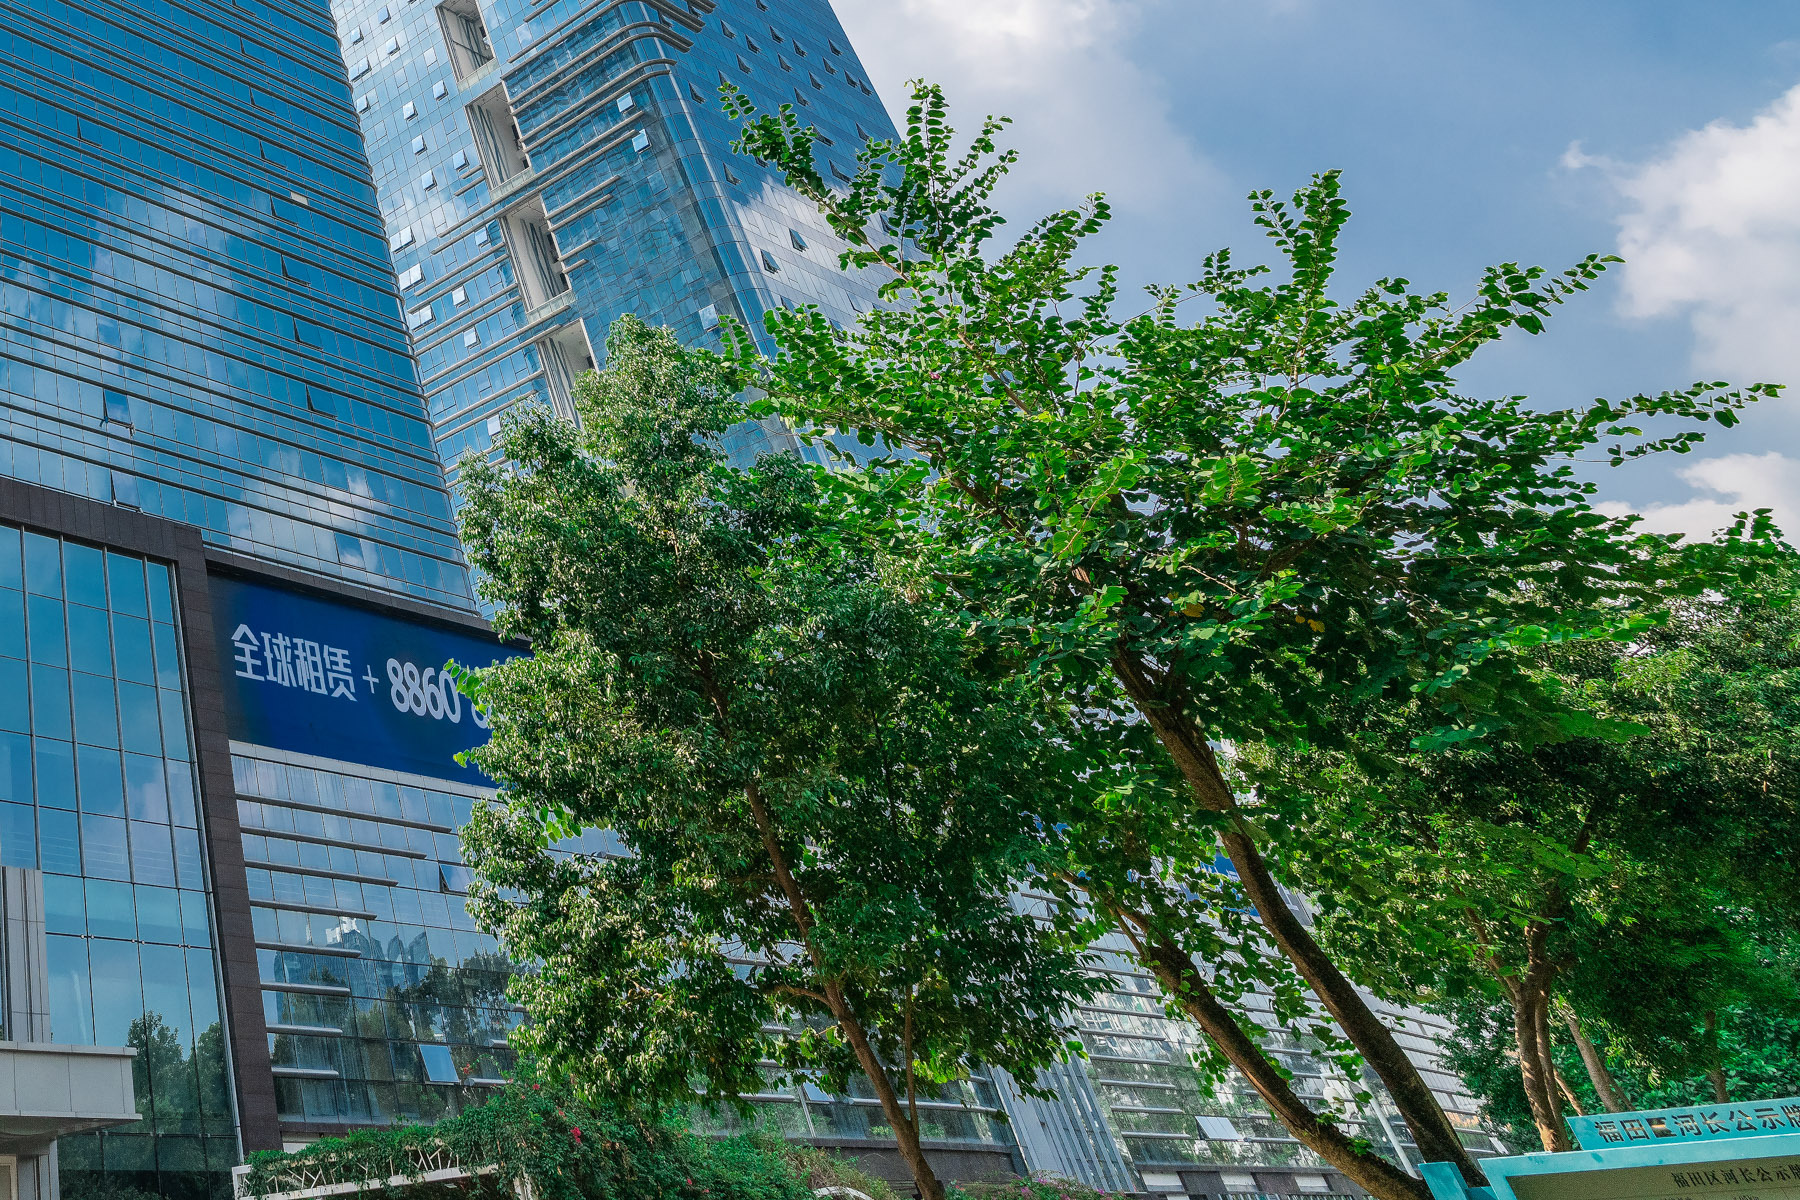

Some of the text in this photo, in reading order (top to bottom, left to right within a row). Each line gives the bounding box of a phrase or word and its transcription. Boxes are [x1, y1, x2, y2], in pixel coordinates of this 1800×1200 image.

[231, 624, 357, 702] 全球租赁
[386, 658, 462, 724] 8860
